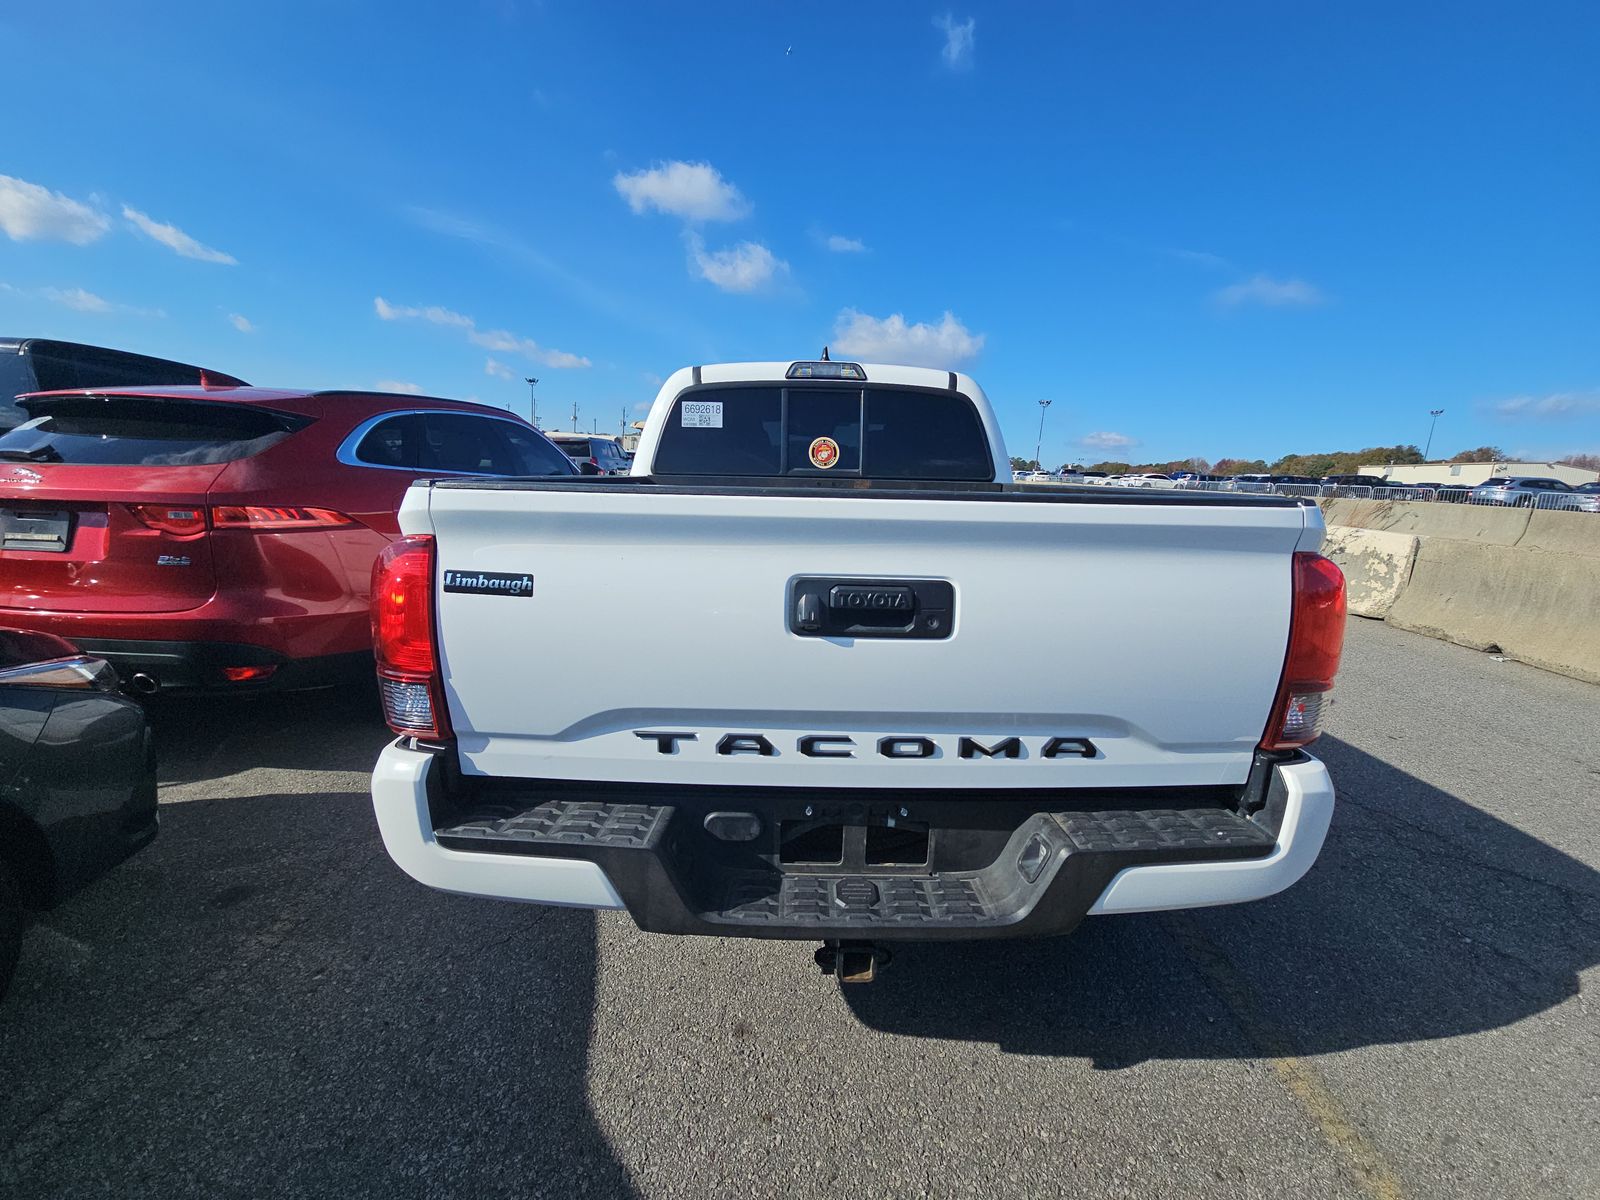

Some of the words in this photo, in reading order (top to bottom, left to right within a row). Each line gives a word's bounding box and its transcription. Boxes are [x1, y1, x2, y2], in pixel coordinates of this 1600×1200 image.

[684, 404, 721, 414] 6692618
[444, 572, 533, 594] Limbaugh
[837, 592, 906, 608] TOYOTA
[632, 730, 1100, 760] TACOMA
